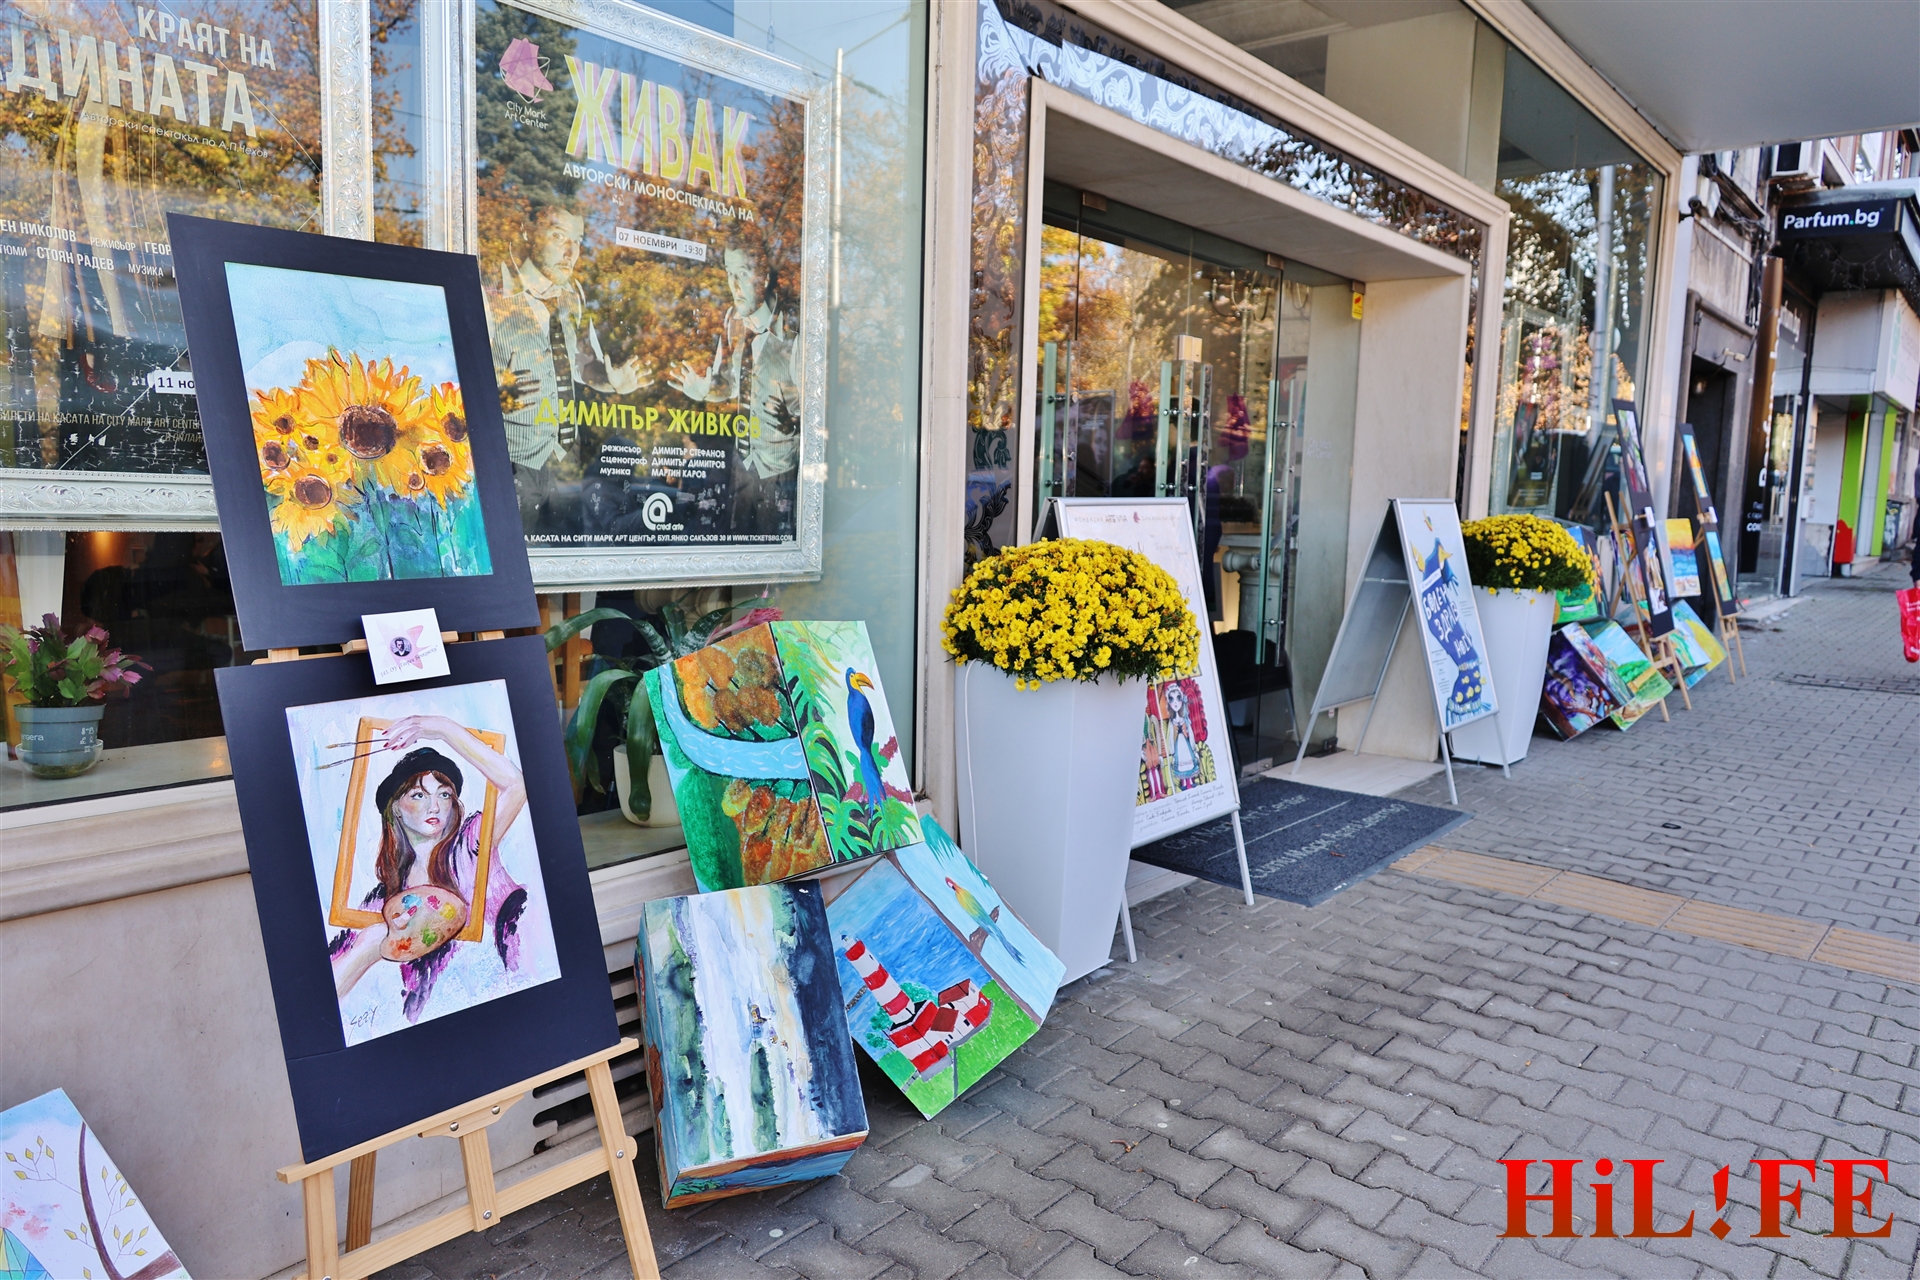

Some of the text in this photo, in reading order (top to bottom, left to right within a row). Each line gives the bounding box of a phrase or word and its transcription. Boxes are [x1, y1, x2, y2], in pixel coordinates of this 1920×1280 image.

[137, 6, 276, 71] КРАЯТ НА
[0, 20, 256, 137] ДИНАТА
[505, 110, 549, 129] Art Center
[506, 101, 547, 120] City Mark
[83, 111, 139, 130] Авторски
[141, 125, 200, 144] спектакъл
[202, 138, 216, 147] по
[564, 54, 752, 200] ЖИВАК
[562, 163, 755, 223] АВТОРСКИ МОНОСПЕКТАКЪЛ НА
[1783, 208, 1881, 229] Parfum.bg
[20, 222, 77, 242] НИКОЛОВ
[90, 237, 136, 252] РЕЖИСЬОР
[618, 231, 704, 256] 07 НОЕМВРИ 19:30
[36, 246, 75, 265] СТОЯН
[77, 253, 115, 271] РАДЕВ
[128, 263, 164, 277] МУЗИКА
[158, 376, 174, 388] 11
[37, 411, 51, 423] НА
[53, 412, 90, 425] КАСАТА
[92, 414, 105, 425] НА
[106, 415, 126, 427] CITY
[534, 397, 761, 439] ДИМИТЪР ЖИВКОВ
[601, 444, 726, 459] режисьор ДИМИТЪР СТЕФАНОВ
[600, 456, 726, 469] сценограф ДИМИТЪР ДИМИТРОВ
[599, 467, 707, 478] музика МАРТИН КАРОВ
[530, 534, 560, 543] КАСАТА
[561, 534, 572, 543] НА
[573, 534, 593, 543] СИТИ
[594, 534, 614, 543] МАРК
[614, 534, 628, 543] АРТ
[690, 534, 719, 542] САКЪЗОВ
[719, 534, 727, 542] 30
